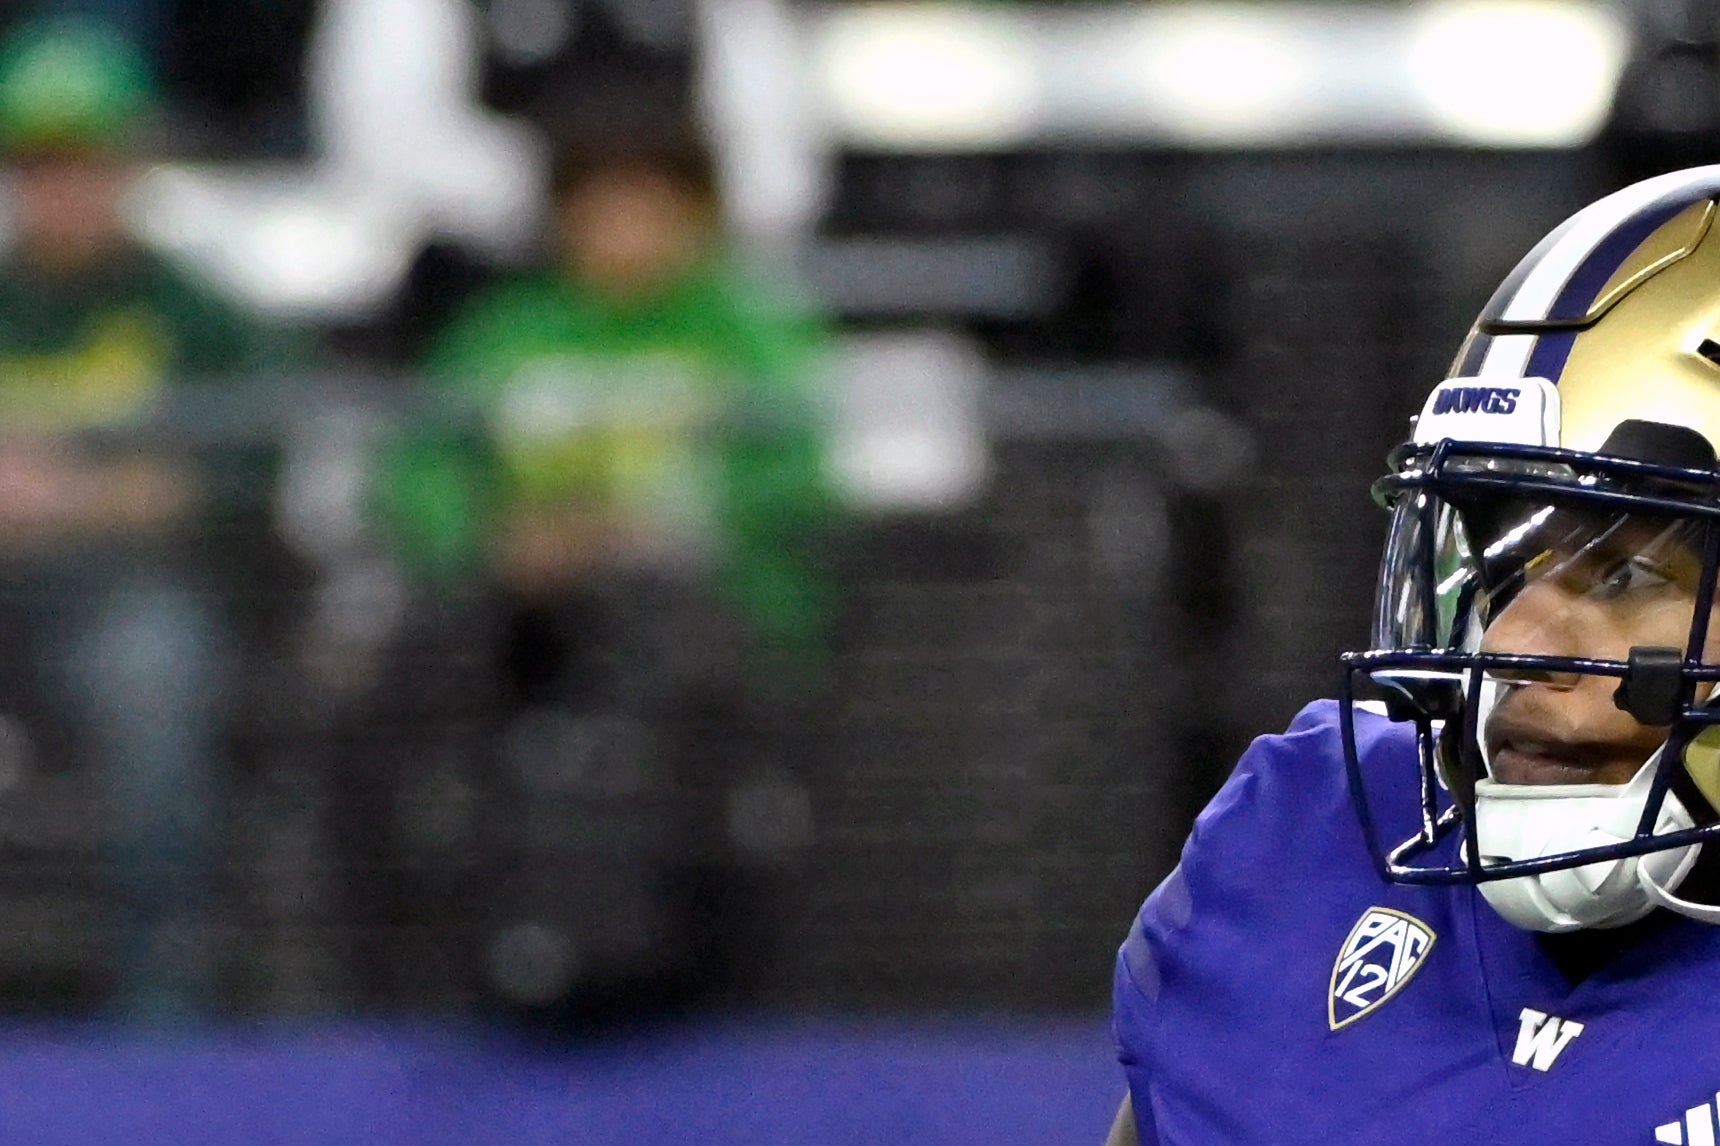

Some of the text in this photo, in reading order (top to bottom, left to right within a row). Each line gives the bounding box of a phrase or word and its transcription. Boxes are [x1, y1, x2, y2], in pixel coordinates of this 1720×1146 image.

[1432, 387, 1521, 415] DAWGS
[1338, 912, 1429, 993] PAC
[1334, 959, 1389, 1008] 12
[1512, 1007, 1585, 1072] W
